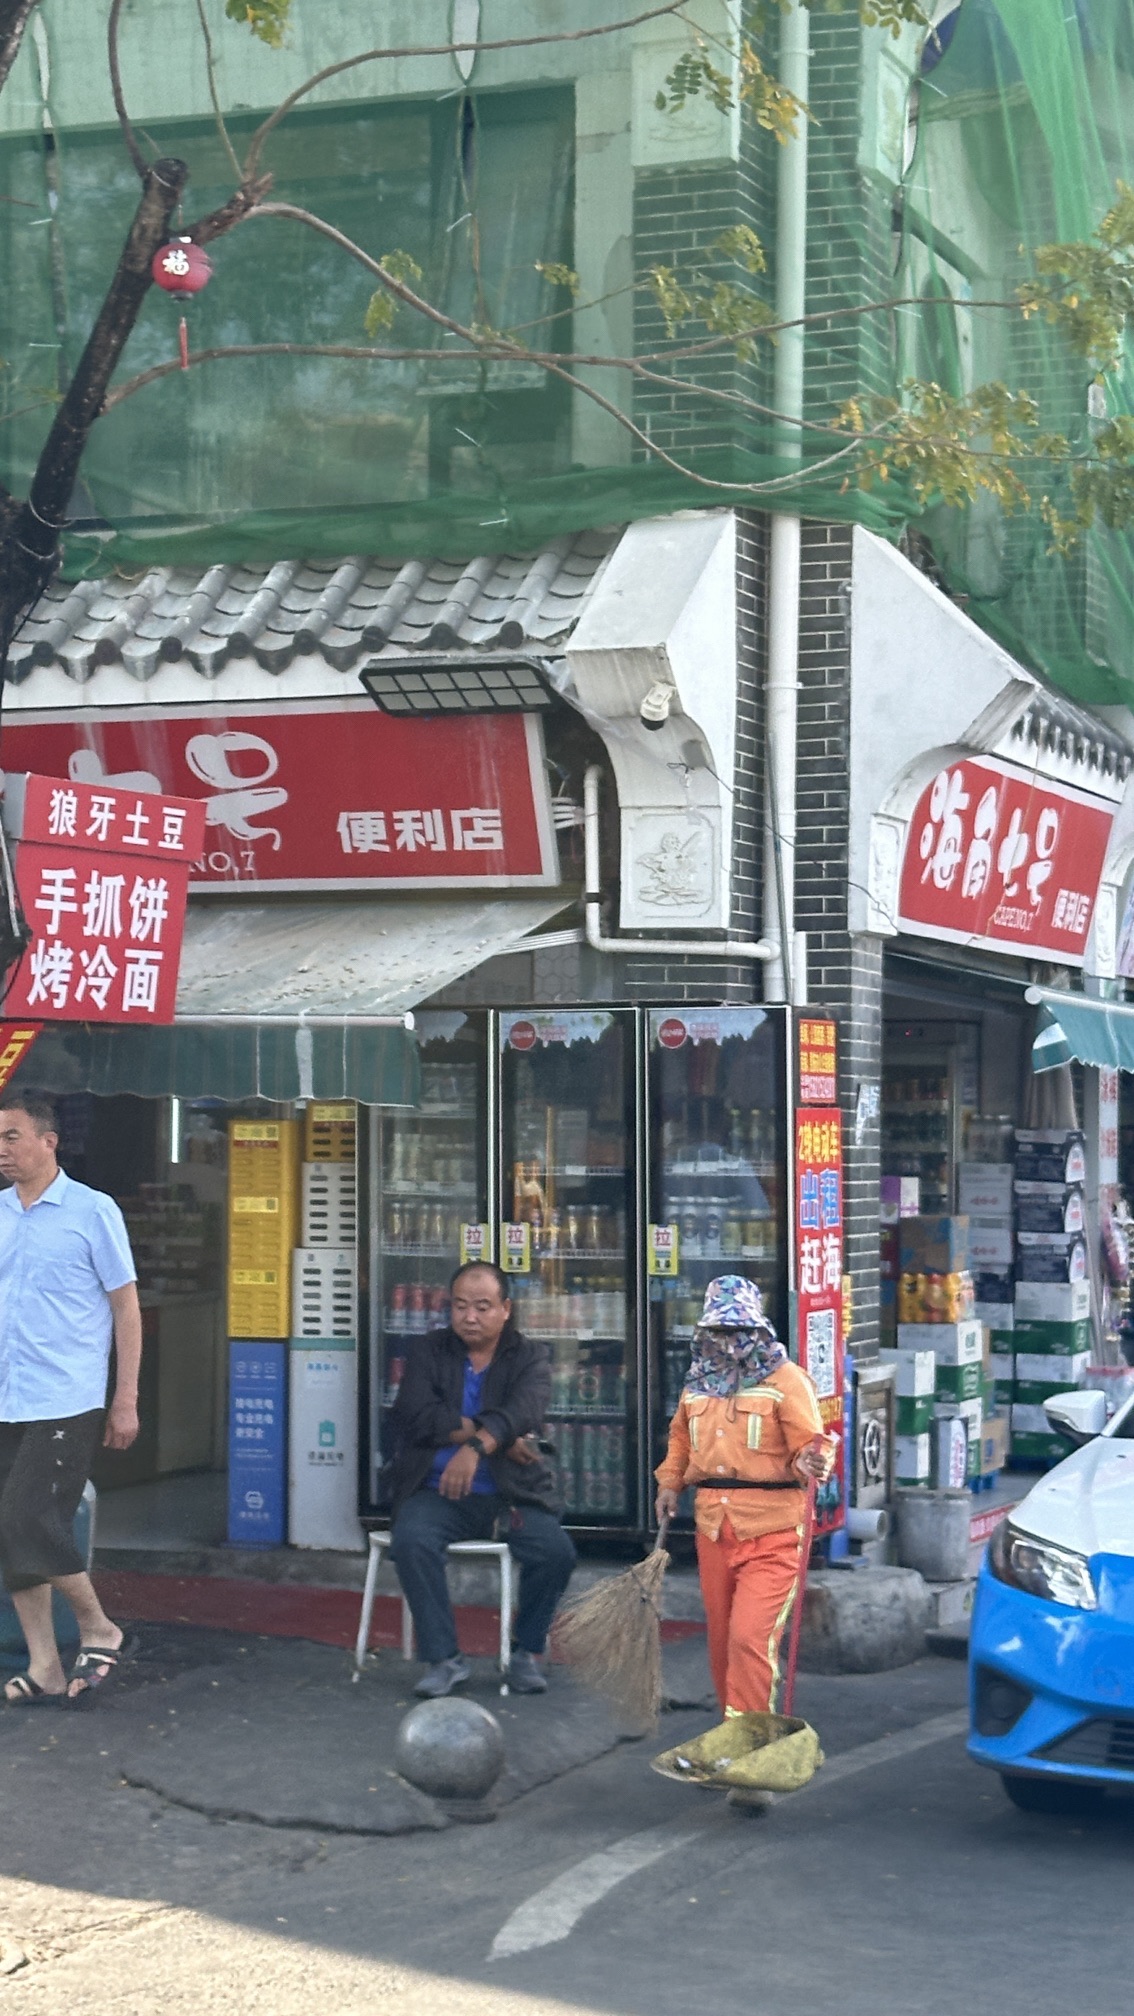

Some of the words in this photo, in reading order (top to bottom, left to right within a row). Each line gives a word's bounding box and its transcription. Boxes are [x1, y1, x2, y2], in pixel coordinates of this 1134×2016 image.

[48, 788, 188, 851] 狼牙土豆
[336, 807, 505, 854] 便利店
[35, 868, 169, 942] 手抓饼
[27, 939, 164, 1013] 烤冷面
[800, 1168, 839, 1230] 出租
[466, 1228, 483, 1245] 拉
[507, 1226, 524, 1244] 拉
[654, 1229, 672, 1247] 拉
[800, 1232, 840, 1295] 赶海
